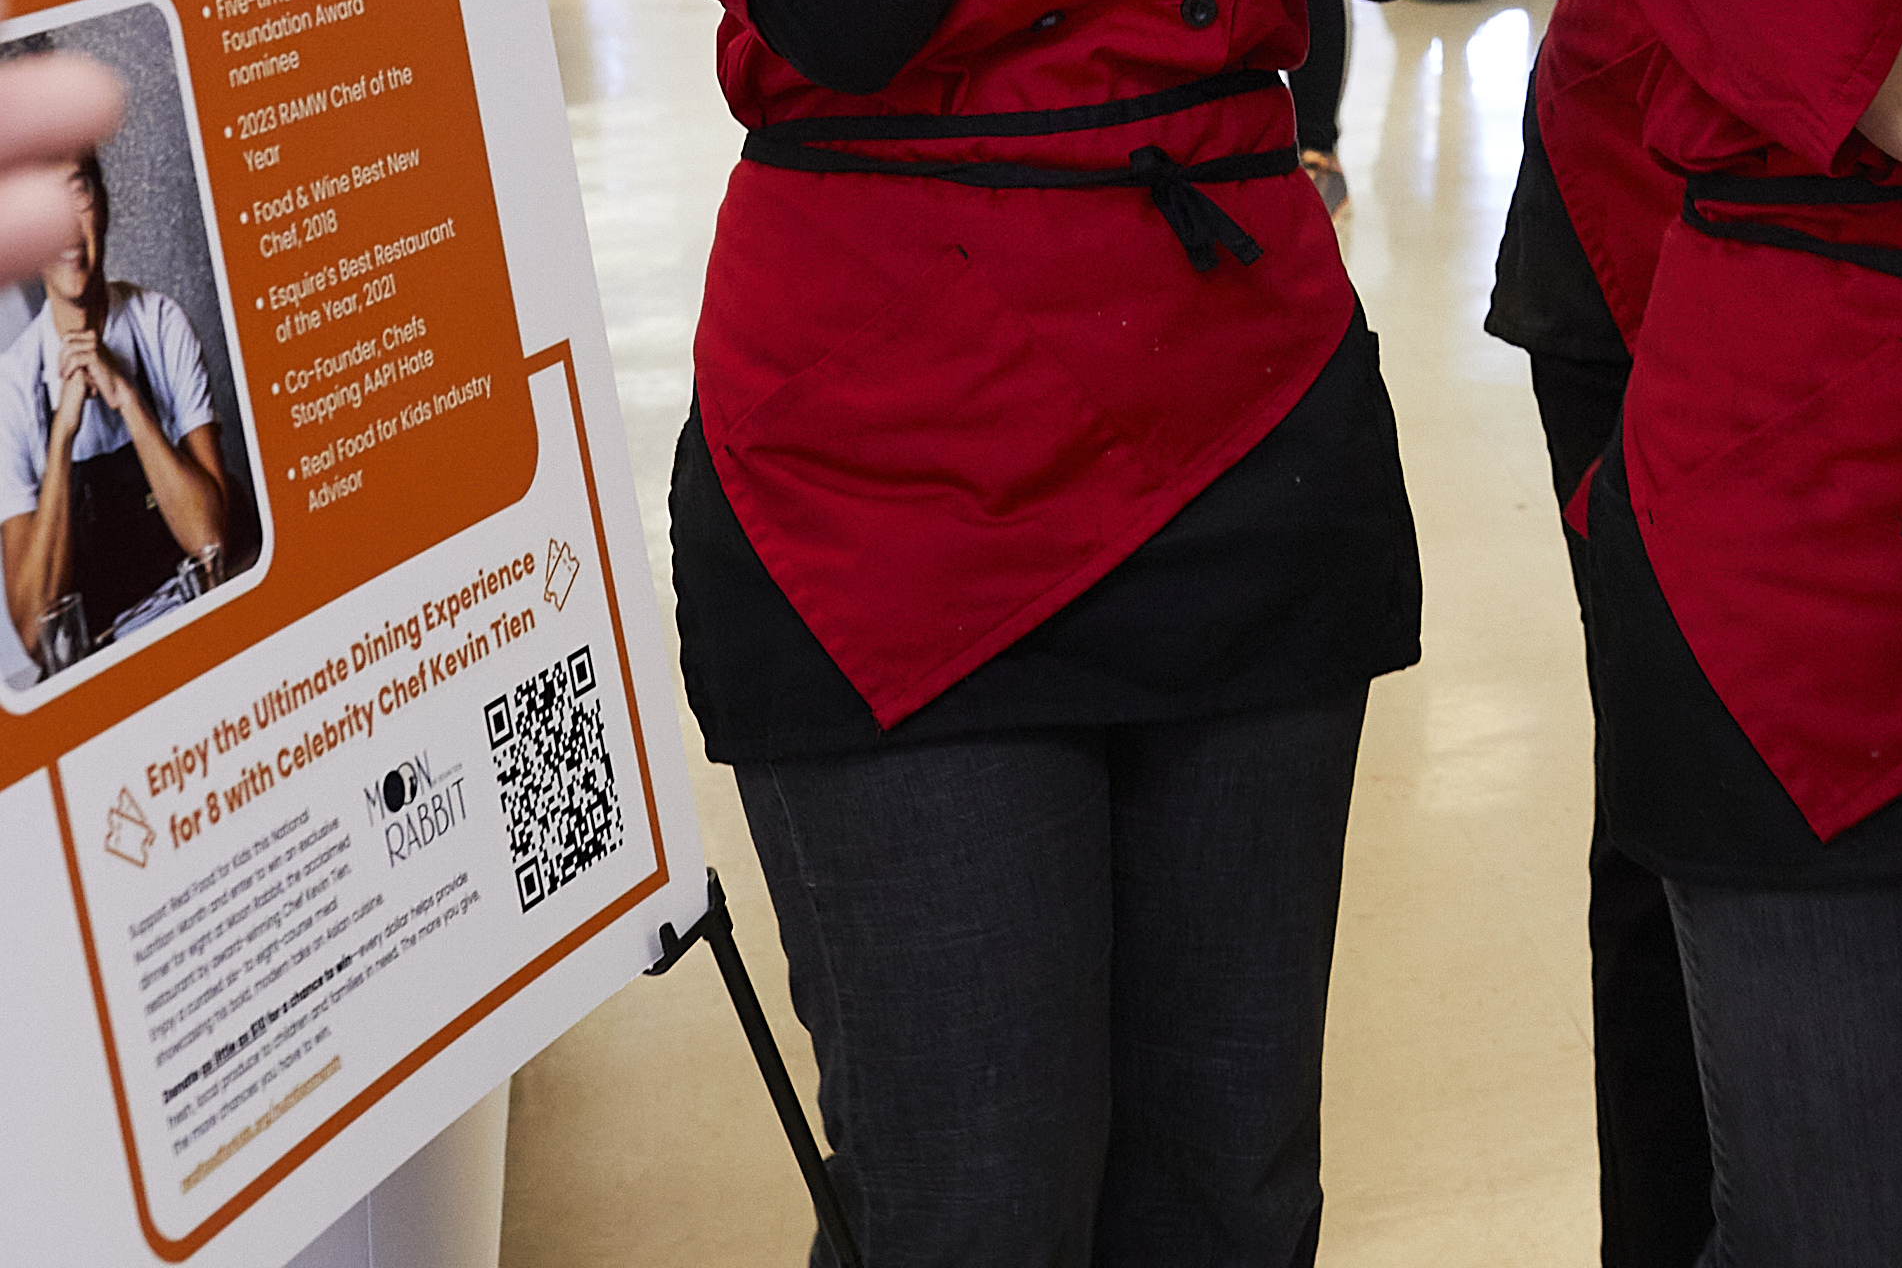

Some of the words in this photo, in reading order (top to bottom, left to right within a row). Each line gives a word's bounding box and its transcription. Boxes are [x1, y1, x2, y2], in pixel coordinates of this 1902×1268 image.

[222, 12, 312, 51] Foundation
[229, 51, 299, 86] nominee
[238, 106, 277, 139] 2023
[278, 91, 327, 123] RAMW
[330, 76, 366, 107] Chef
[369, 70, 384, 95] of
[387, 67, 412, 89] the
[243, 145, 279, 170] Year
[253, 190, 294, 223] Food
[296, 186, 309, 209] &
[310, 174, 349, 201] Wine
[351, 159, 385, 188] Best
[387, 149, 419, 174] New
[260, 223, 301, 257] Chef,
[303, 209, 337, 241] 2018
[269, 267, 337, 309] Esquire's
[338, 251, 373, 281] Best
[374, 219, 454, 268] Restaurant
[276, 315, 291, 343] of
[294, 306, 321, 334] the
[322, 294, 361, 320] Year,
[363, 273, 396, 306] 2021
[285, 340, 380, 392] Co-Founder,
[382, 316, 426, 349] Chefs
[291, 383, 361, 427] Stopping
[364, 362, 396, 394] AAPI
[398, 349, 433, 378] Hate
[300, 444, 335, 478] Real
[336, 424, 375, 460] Food
[376, 417, 397, 441] for
[400, 401, 432, 430] Kids
[433, 376, 490, 413] Industry
[309, 470, 362, 511] Advisor
[147, 740, 208, 796] Enjoy
[213, 716, 250, 753] the
[254, 658, 347, 728] Ultimate
[351, 616, 421, 671] Dining
[423, 554, 534, 629] Experience
[169, 809, 201, 848] for
[206, 791, 221, 824] 8
[224, 762, 274, 812] with
[277, 702, 373, 777] Celebrity
[378, 661, 426, 714] Chef
[429, 633, 489, 685] Kevin
[490, 608, 535, 647] Tien
[363, 749, 433, 827] MOON
[385, 777, 467, 868] RABBIT
